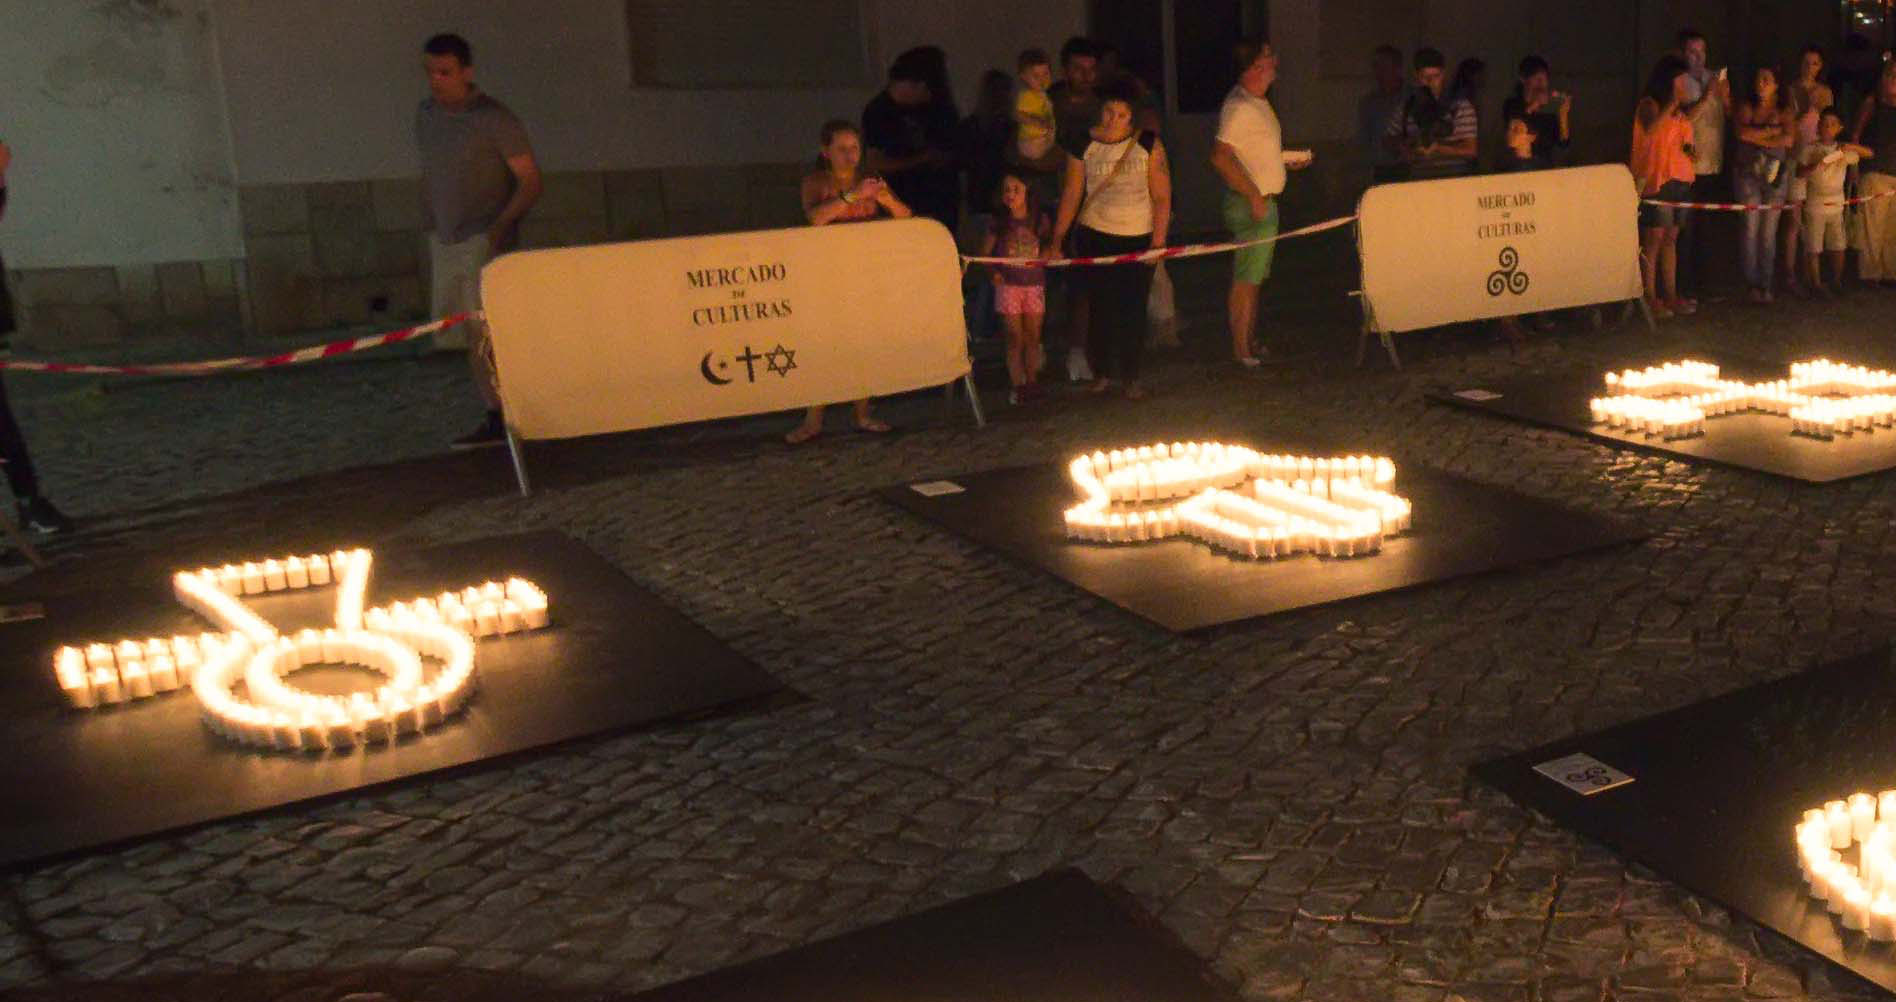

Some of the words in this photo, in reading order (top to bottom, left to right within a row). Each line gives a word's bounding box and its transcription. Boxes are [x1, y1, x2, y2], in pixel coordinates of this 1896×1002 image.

[1478, 192, 1536, 209] MERCADO
[686, 263, 786, 287] MERCADO
[692, 299, 793, 326] CULTURAS
